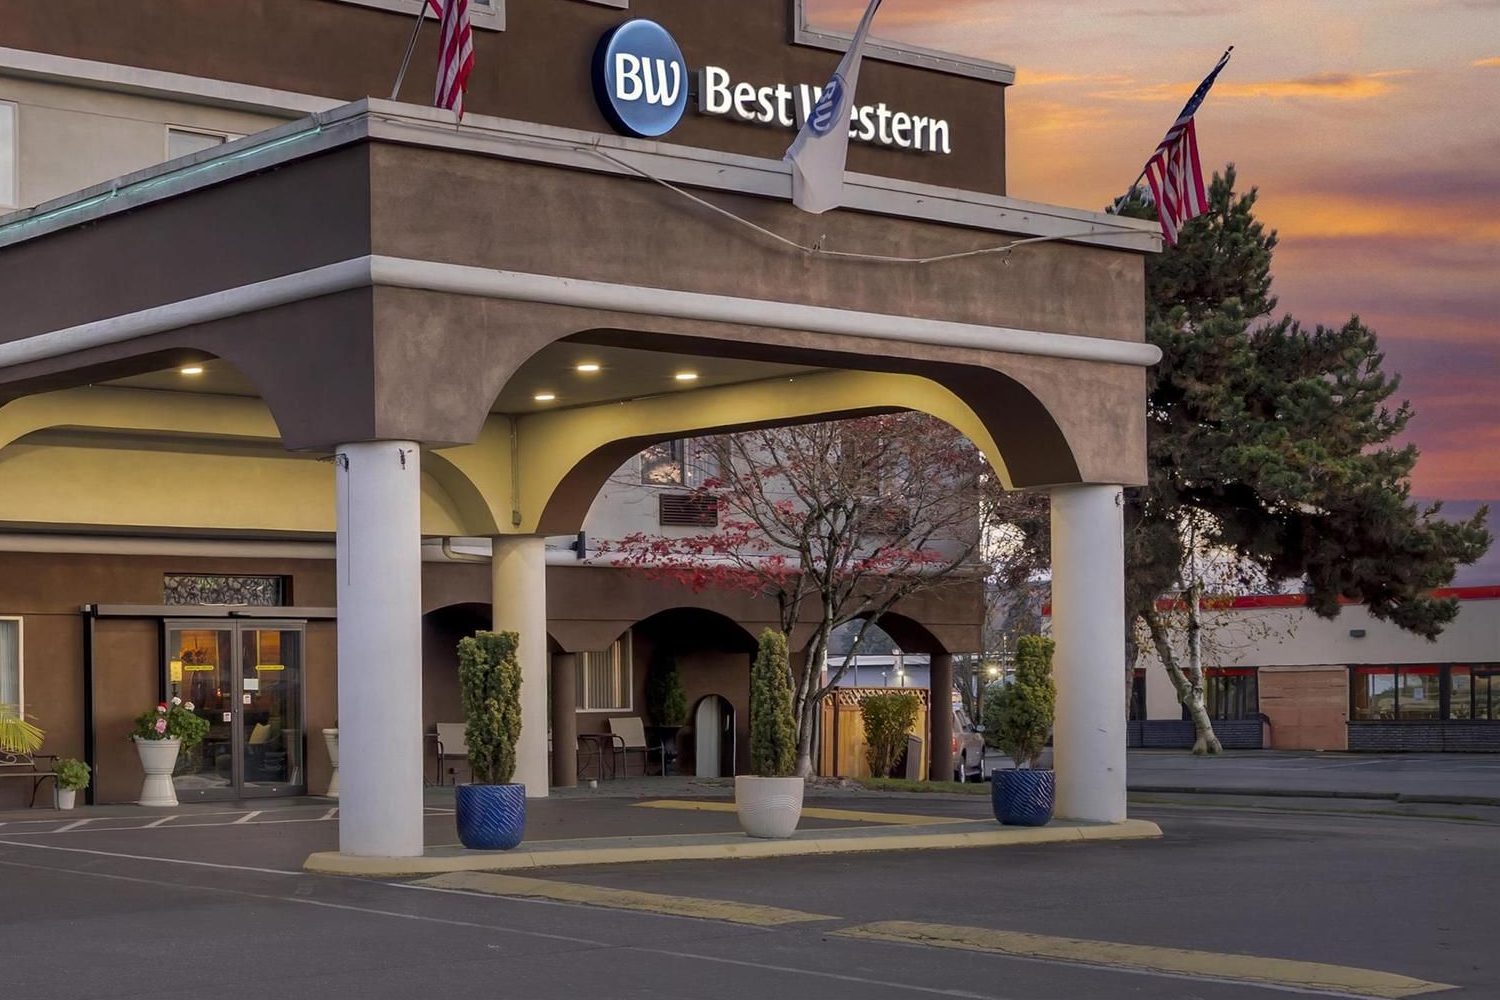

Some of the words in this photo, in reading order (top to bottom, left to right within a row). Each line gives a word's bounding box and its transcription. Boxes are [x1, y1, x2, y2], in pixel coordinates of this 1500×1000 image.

[615, 53, 680, 106] BW
[706, 65, 793, 127] Best
[813, 81, 837, 131] BW
